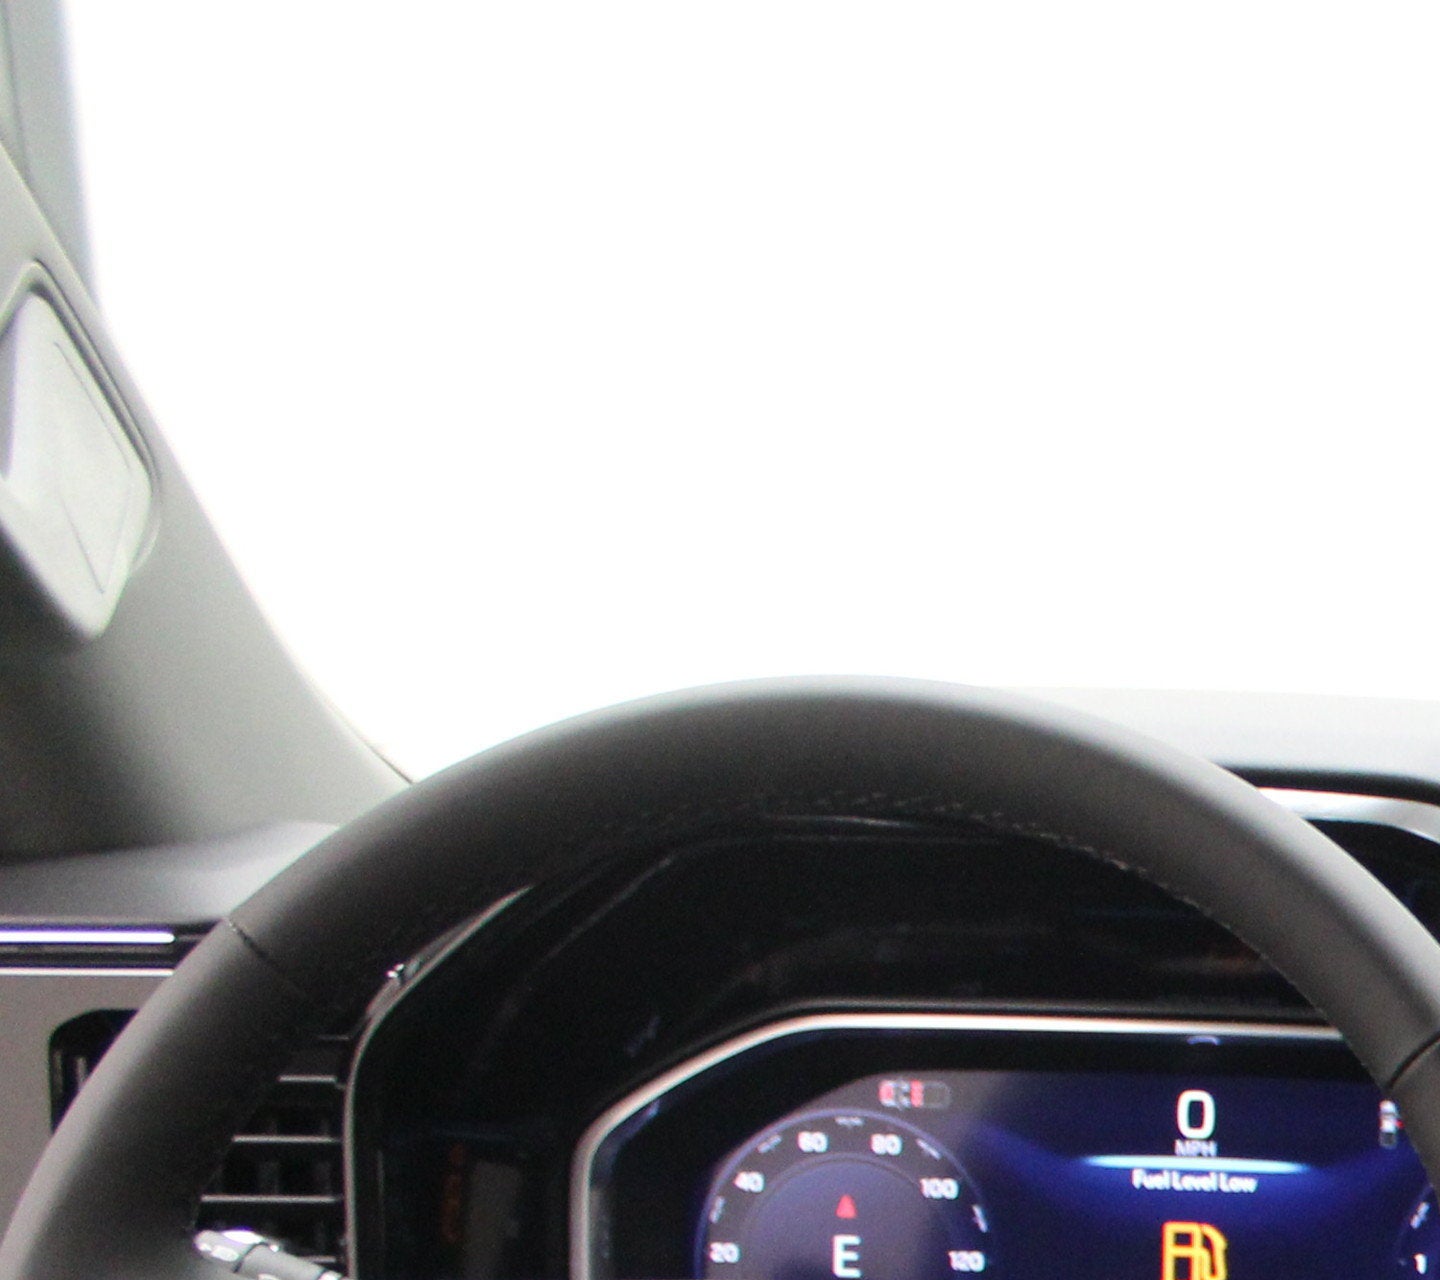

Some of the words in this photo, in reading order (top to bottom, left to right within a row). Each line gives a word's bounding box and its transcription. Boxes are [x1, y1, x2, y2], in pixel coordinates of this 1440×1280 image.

[1177, 1089, 1215, 1138] 0
[1174, 1140, 1217, 1156] MPH
[920, 1177, 959, 1200] 100
[1132, 1168, 1170, 1190] Fuel
[1172, 1170, 1218, 1191] Level
[1220, 1172, 1258, 1193] Low
[710, 1242, 740, 1263] 20
[832, 1235, 862, 1278] E
[949, 1251, 986, 1272] 120
